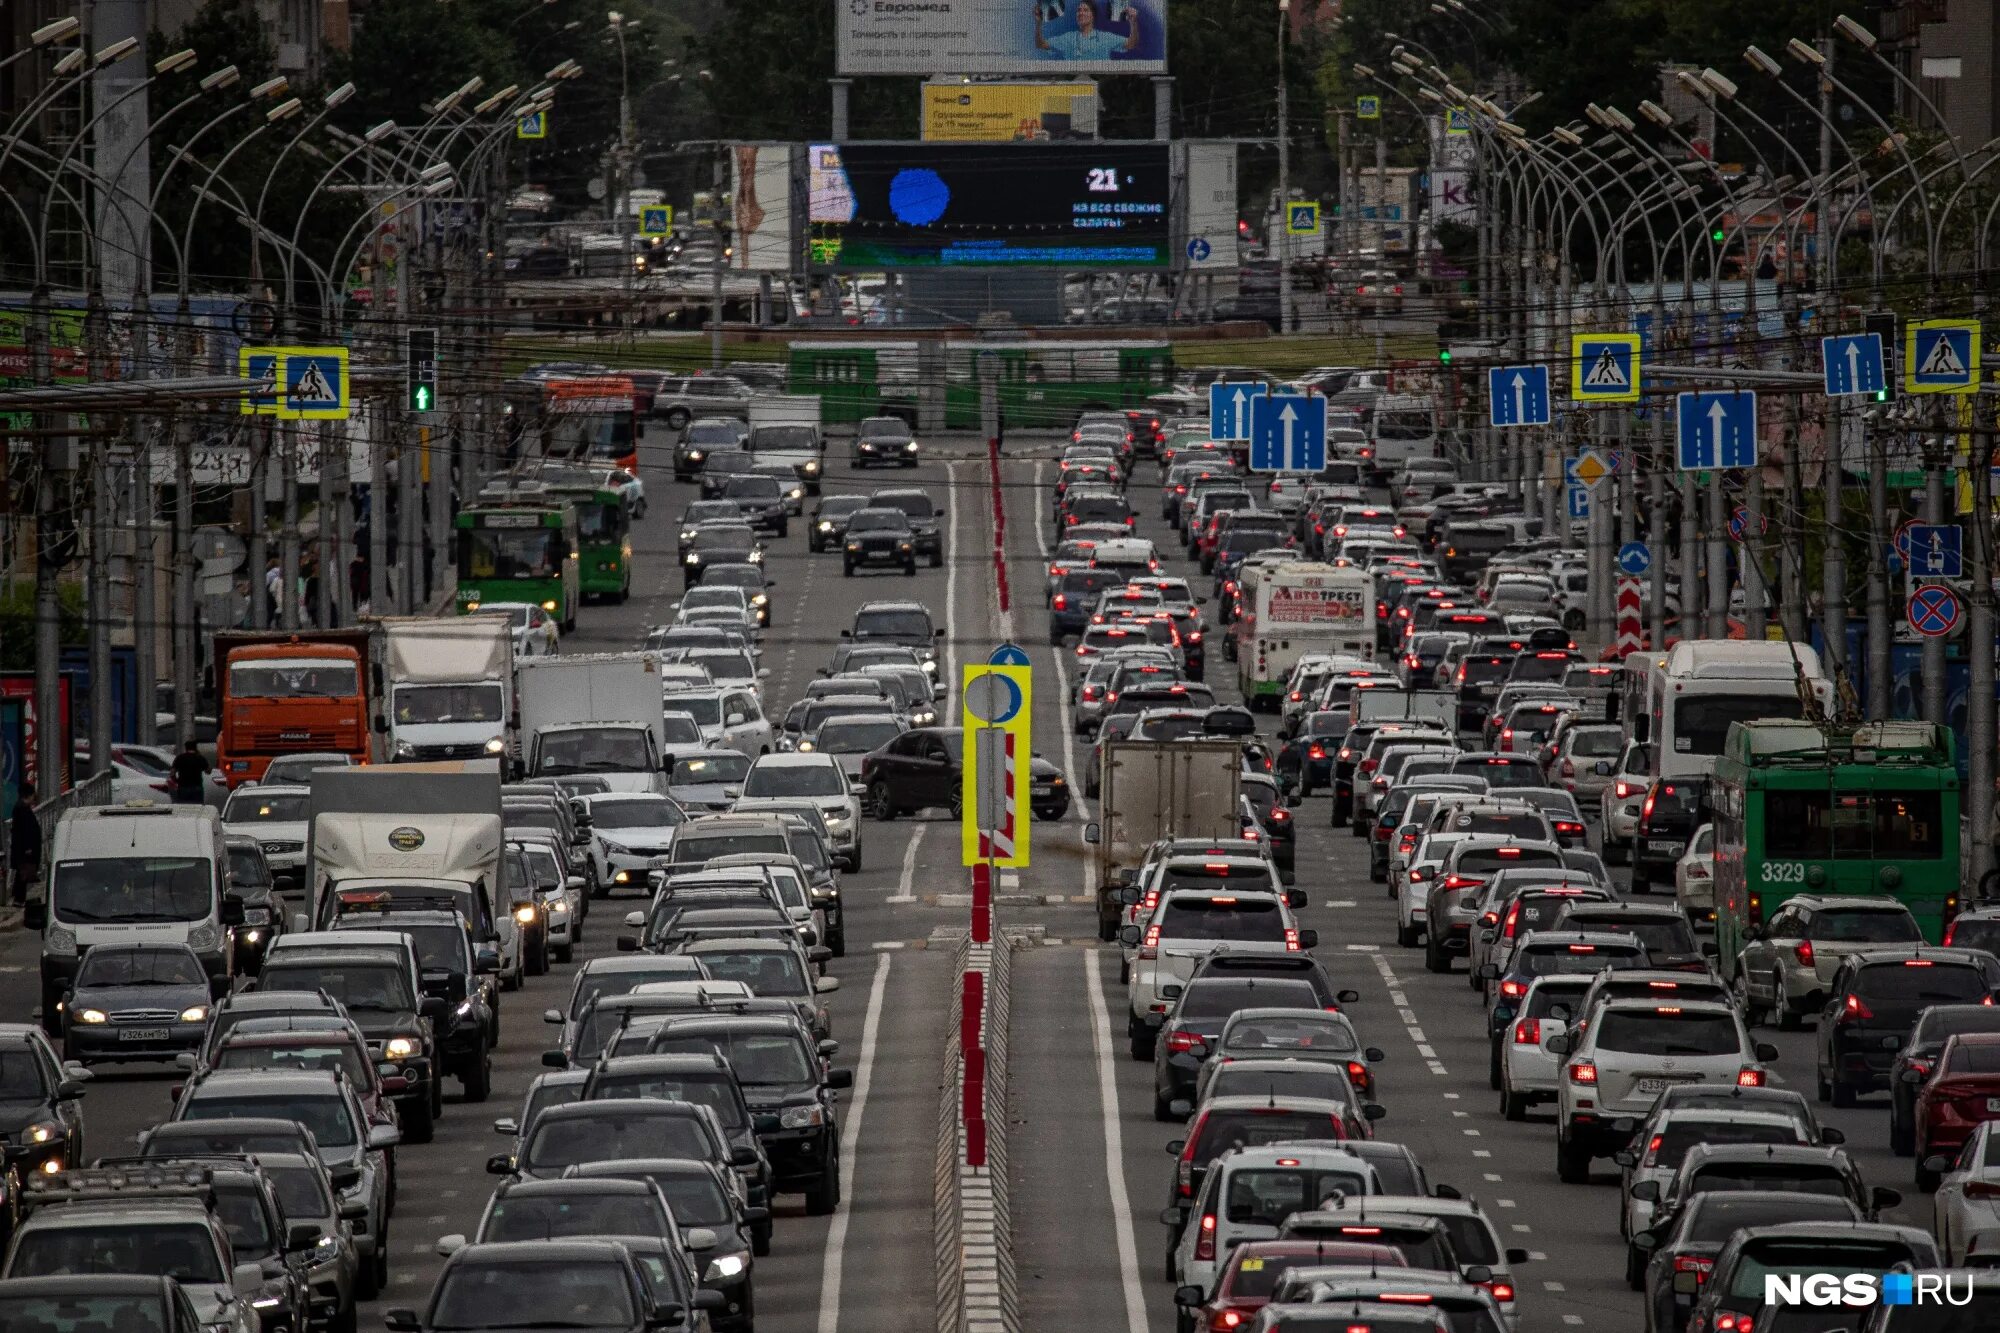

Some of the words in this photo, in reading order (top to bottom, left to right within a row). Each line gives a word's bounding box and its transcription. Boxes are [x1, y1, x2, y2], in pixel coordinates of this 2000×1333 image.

[874, 1, 950, 13] Евромед
[1072, 203, 1088, 213] на
[1090, 203, 1112, 213] все
[1114, 203, 1162, 213] свежие
[1761, 862, 1805, 882] 3329
